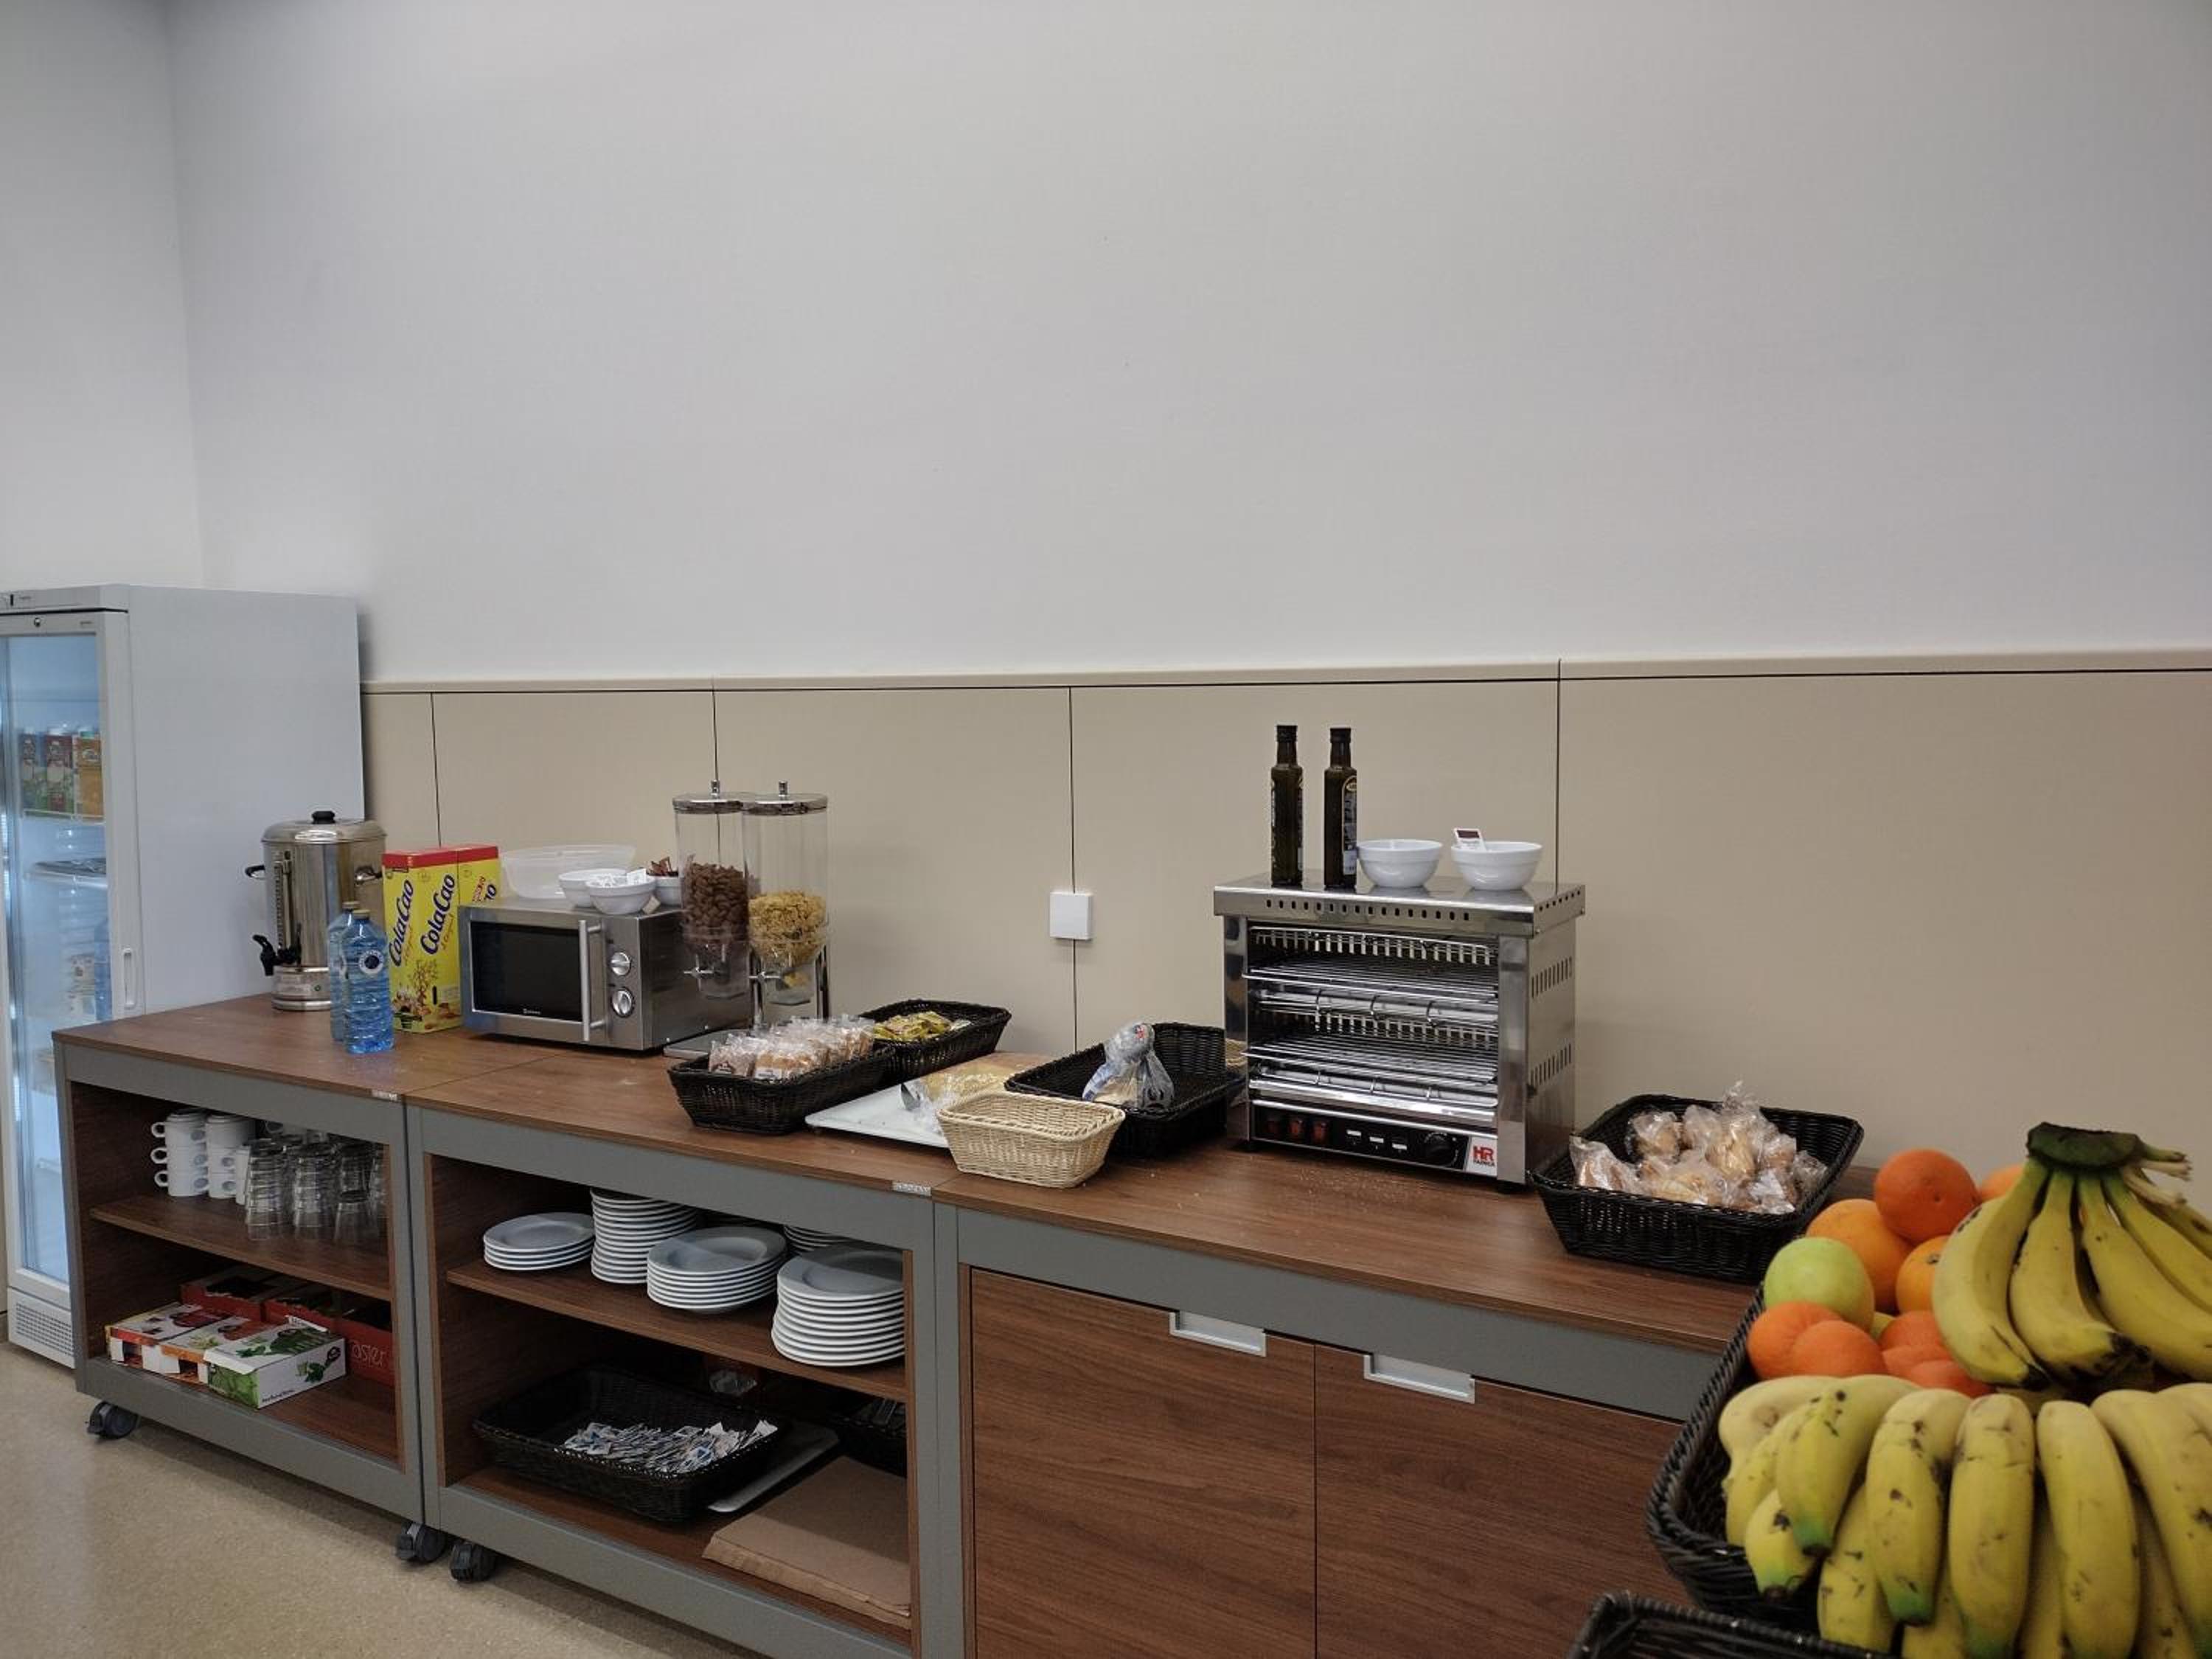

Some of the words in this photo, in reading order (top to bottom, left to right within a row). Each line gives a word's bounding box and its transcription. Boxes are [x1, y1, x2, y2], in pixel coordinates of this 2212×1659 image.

[389, 879, 414, 967] ColaCao
[420, 874, 455, 955] ColaCao
[1473, 1146, 1494, 1161] HR
